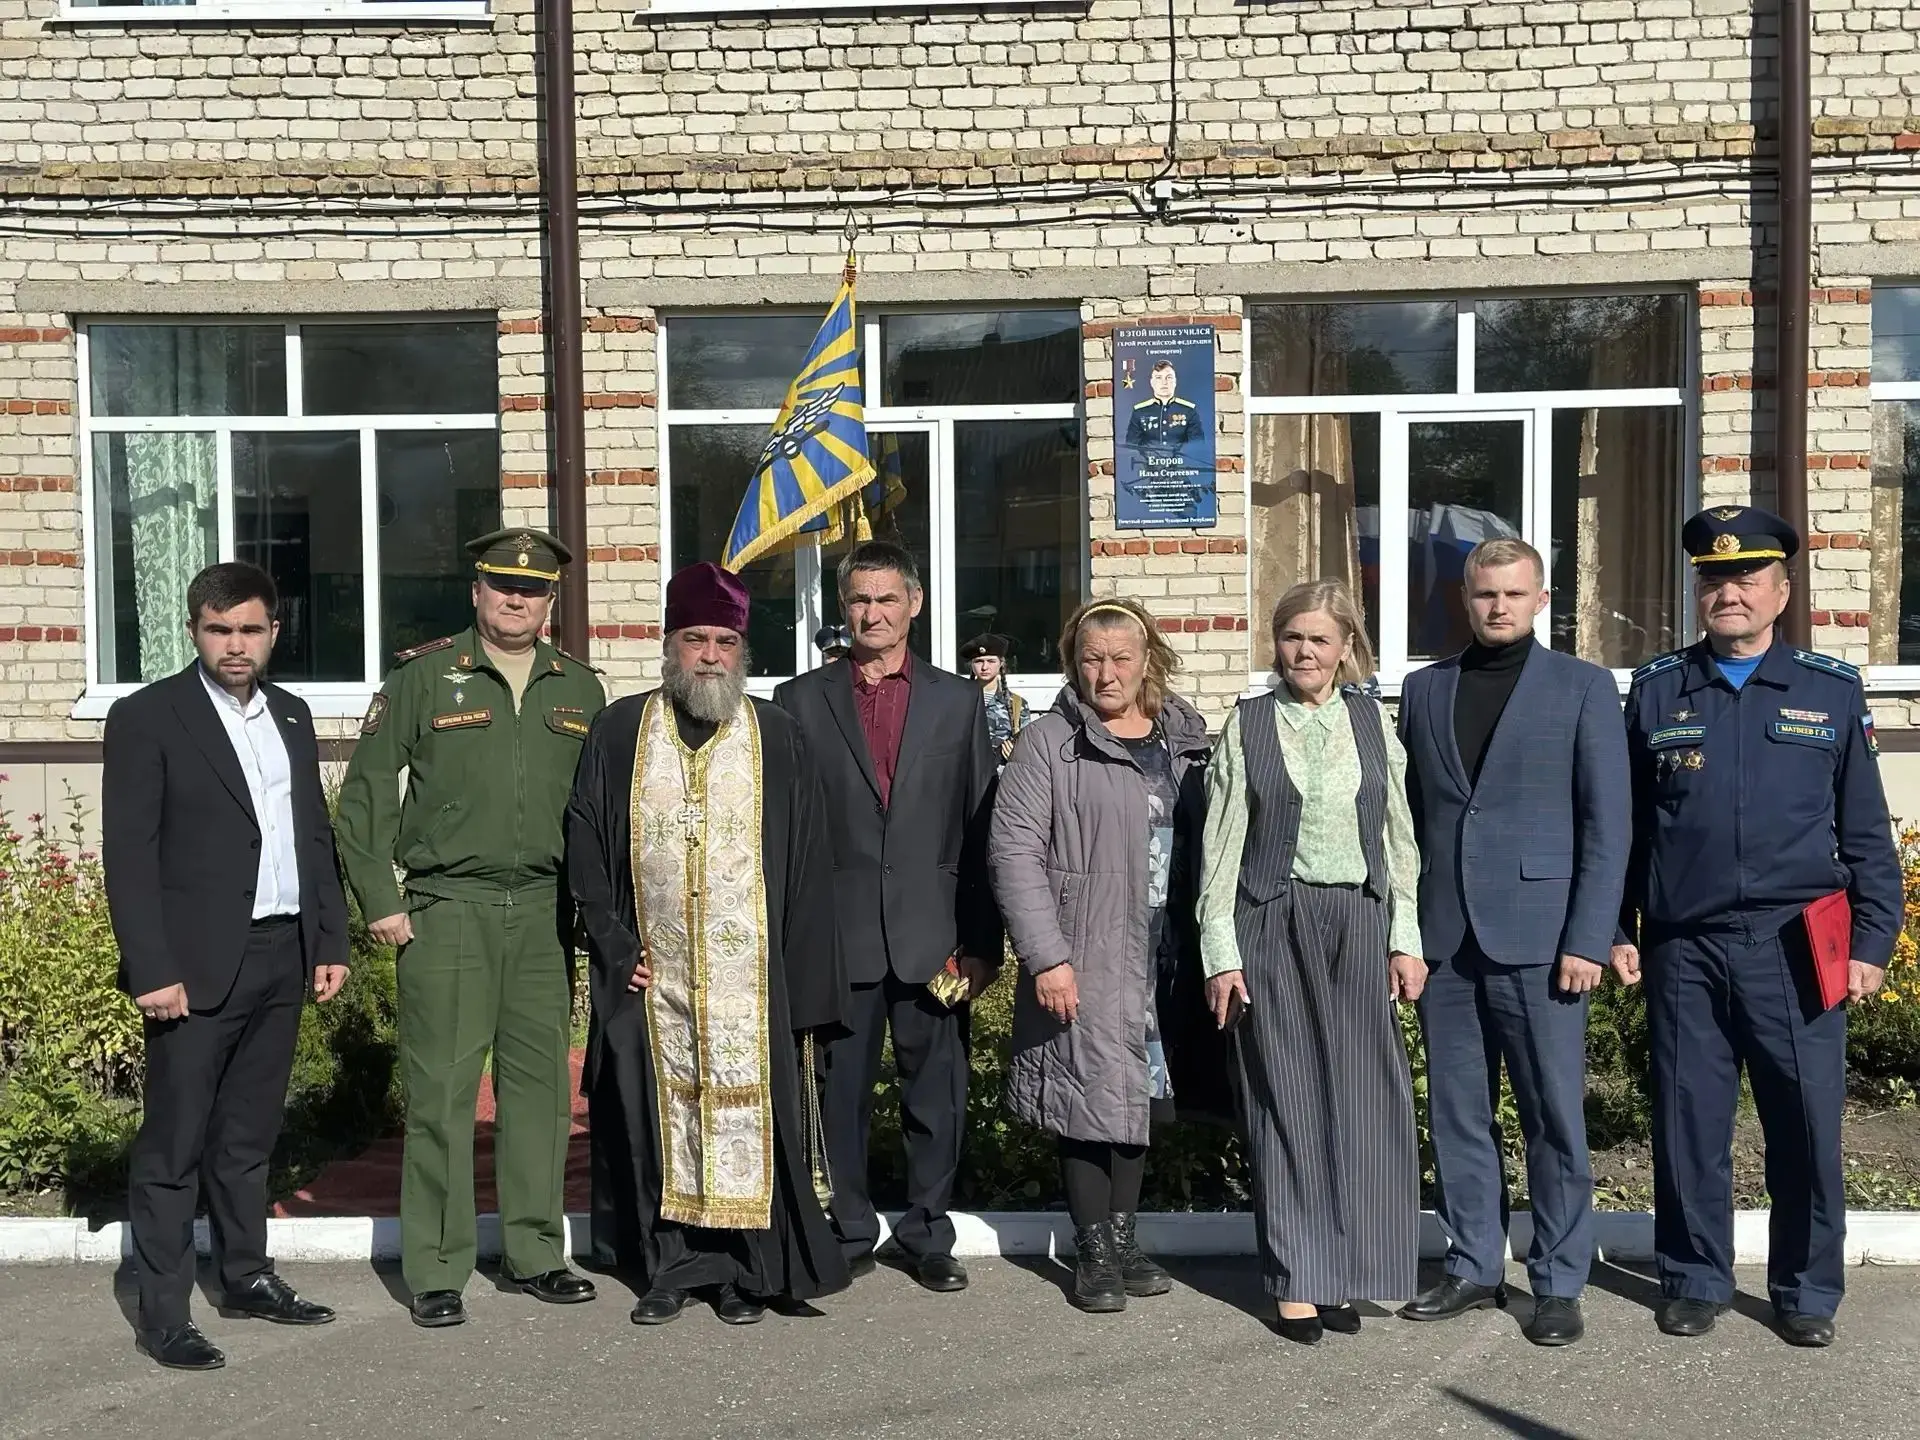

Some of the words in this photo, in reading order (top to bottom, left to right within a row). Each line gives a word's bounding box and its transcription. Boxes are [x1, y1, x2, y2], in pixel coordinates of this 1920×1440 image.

[1126, 329, 1147, 337] ЭТОЙ
[1149, 329, 1177, 337] ШКОЛЕ
[1178, 328, 1210, 336] УЧИЛСЯ
[1148, 456, 1184, 467] Егоров
[1160, 469, 1199, 478] Сергеевич
[1781, 725, 1814, 735] МАТВЕЕВ
